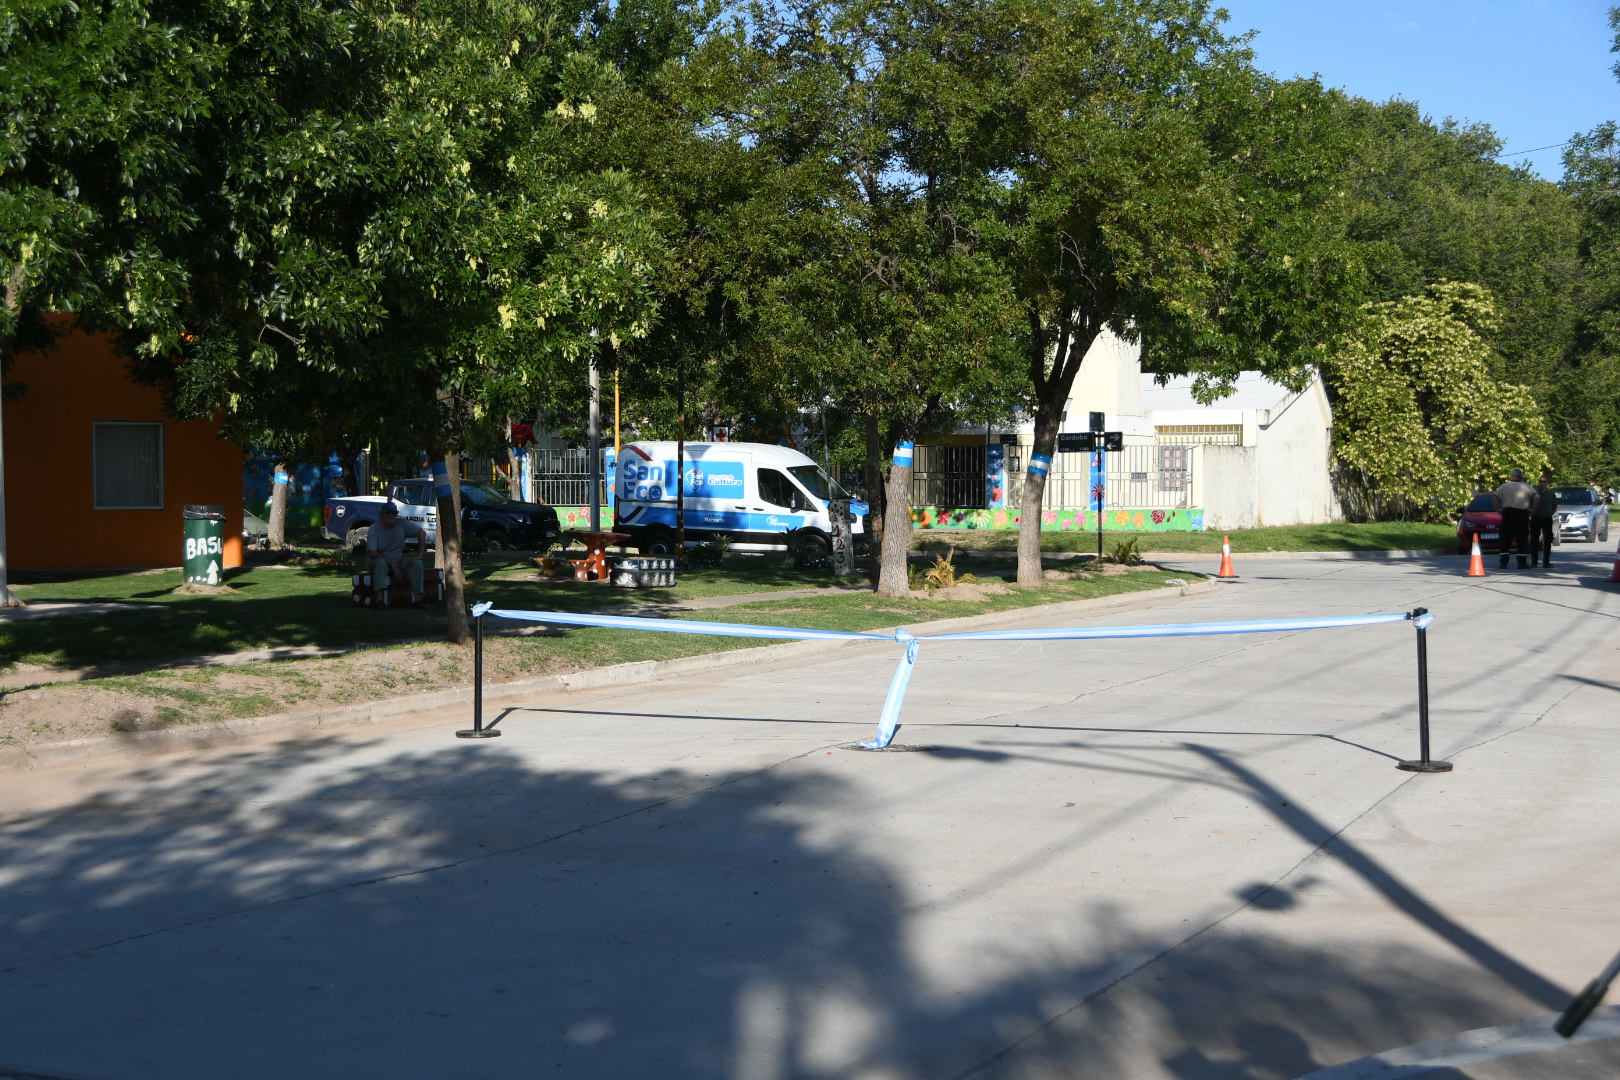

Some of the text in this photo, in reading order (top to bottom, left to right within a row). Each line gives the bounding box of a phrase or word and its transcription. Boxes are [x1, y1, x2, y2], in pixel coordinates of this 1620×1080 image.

[623, 459, 663, 480] San
[690, 472, 704, 480] San
[623, 481, 663, 501] Fco
[836, 539, 845, 550] 2
[836, 552, 845, 563] 3
